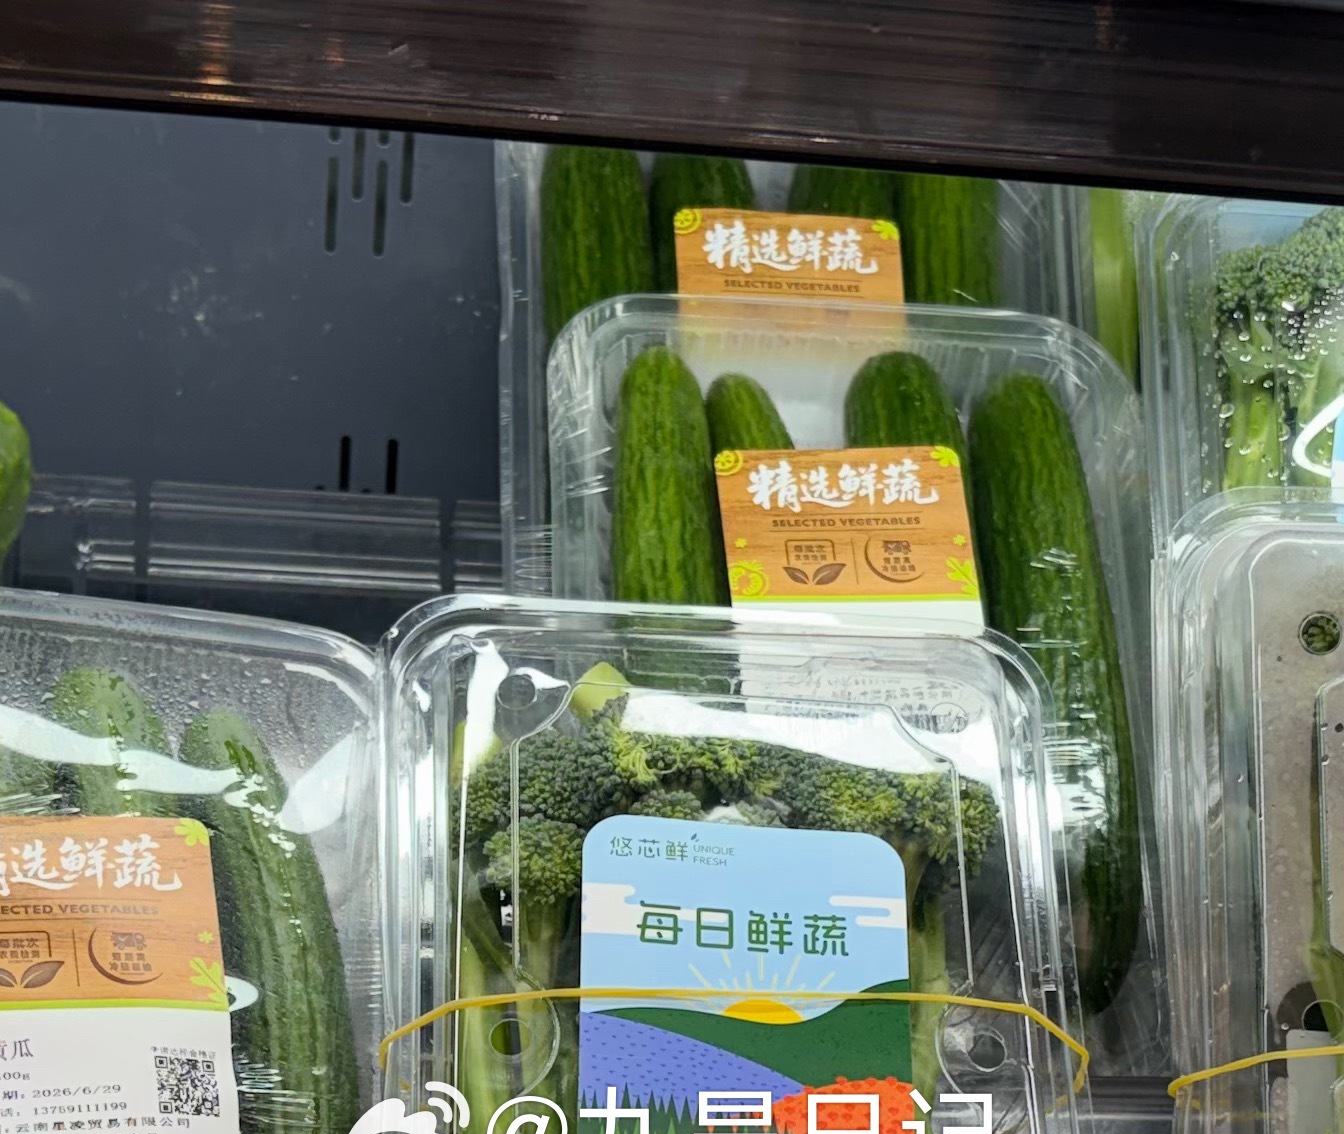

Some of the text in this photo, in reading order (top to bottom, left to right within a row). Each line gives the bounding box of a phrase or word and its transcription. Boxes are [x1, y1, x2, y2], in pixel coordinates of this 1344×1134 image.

[703, 219, 879, 274] 精选鲜蔬
[723, 278, 860, 293] SELECTED VEGETABLES
[746, 458, 939, 513] 精选鲜蔬
[772, 516, 921, 528] SELECTED VEGETABLES
[609, 836, 688, 861] 悠芯鲜
[692, 844, 735, 857] UNIQUE
[692, 856, 728, 867] FRESH
[57, 903, 159, 916] VEGETABLES
[637, 900, 849, 956] 每日鲜蔬
